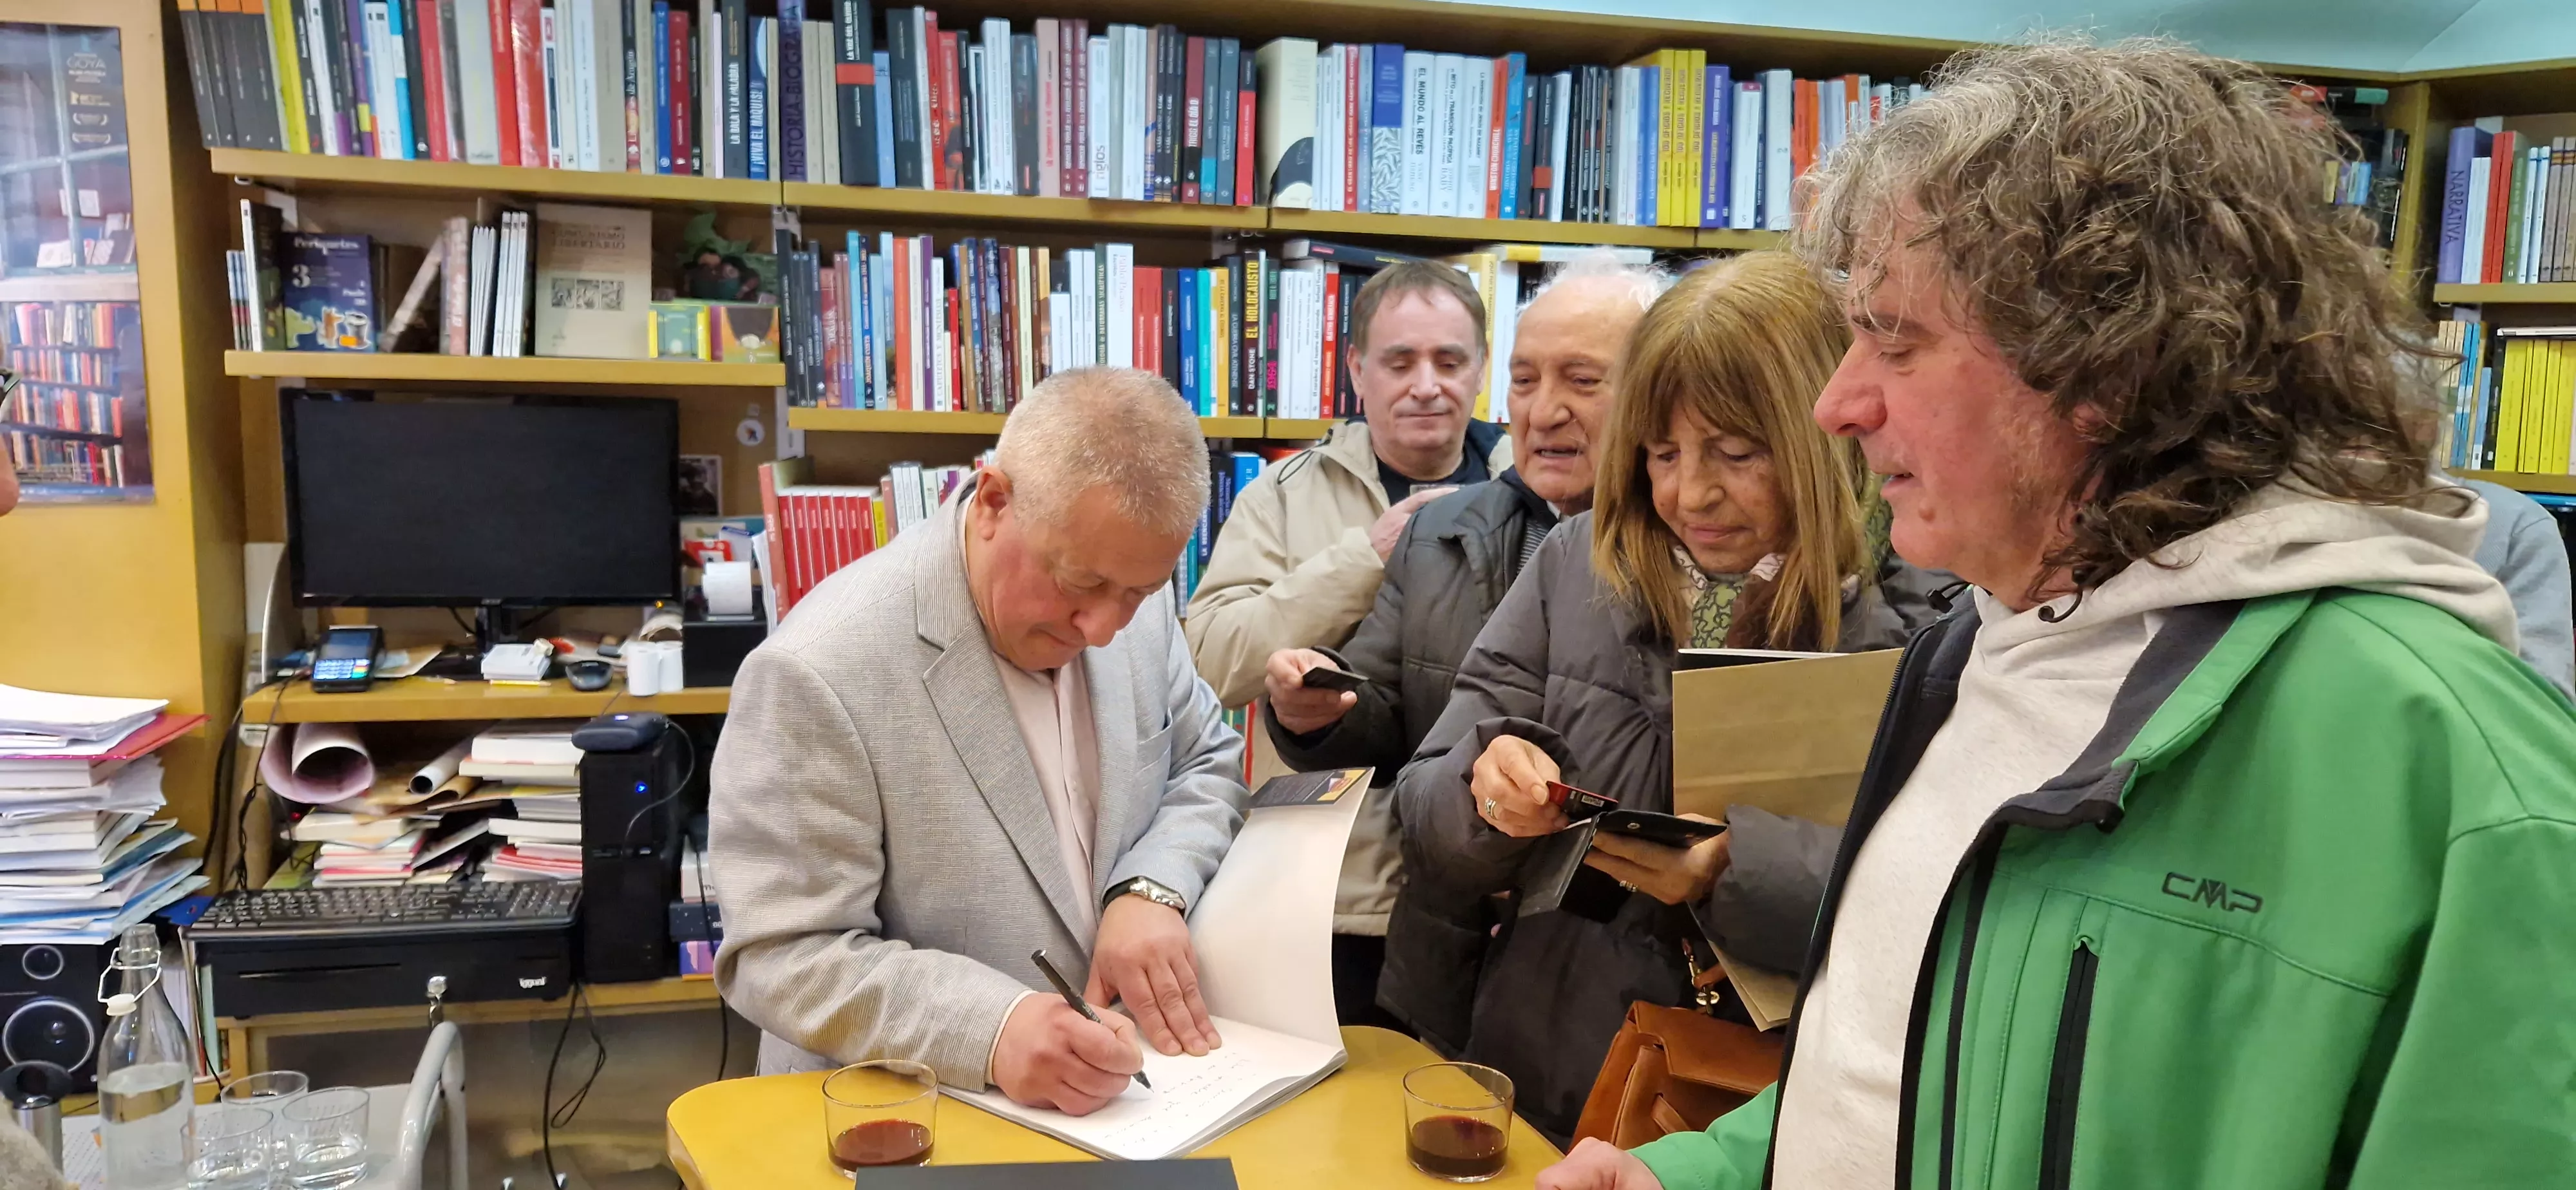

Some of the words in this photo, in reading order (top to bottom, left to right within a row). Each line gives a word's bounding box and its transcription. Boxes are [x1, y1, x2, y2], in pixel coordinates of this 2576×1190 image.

[1417, 68, 1426, 78] EL
[728, 97, 739, 107] LA
[1417, 81, 1426, 112] MUNDO
[1188, 118, 1199, 128] EL
[1416, 115, 1425, 125] AL
[730, 135, 741, 144] LA
[750, 128, 764, 140] EL
[1415, 128, 1425, 155] REVÉS
[1092, 145, 1108, 180] riglos
[1488, 162, 1499, 191] WINSTON
[2445, 170, 2465, 245] NARRATIVA
[292, 264, 311, 288] 3
[1119, 254, 1127, 279] Pablo
[1119, 281, 1127, 313] Picasso
[1245, 261, 1258, 322] HOLOCAUSTO
[1245, 326, 1258, 339] EL
[1248, 348, 1256, 373] STONE
[1202, 547, 1208, 557] LA
[2161, 871, 2264, 914] CMP
